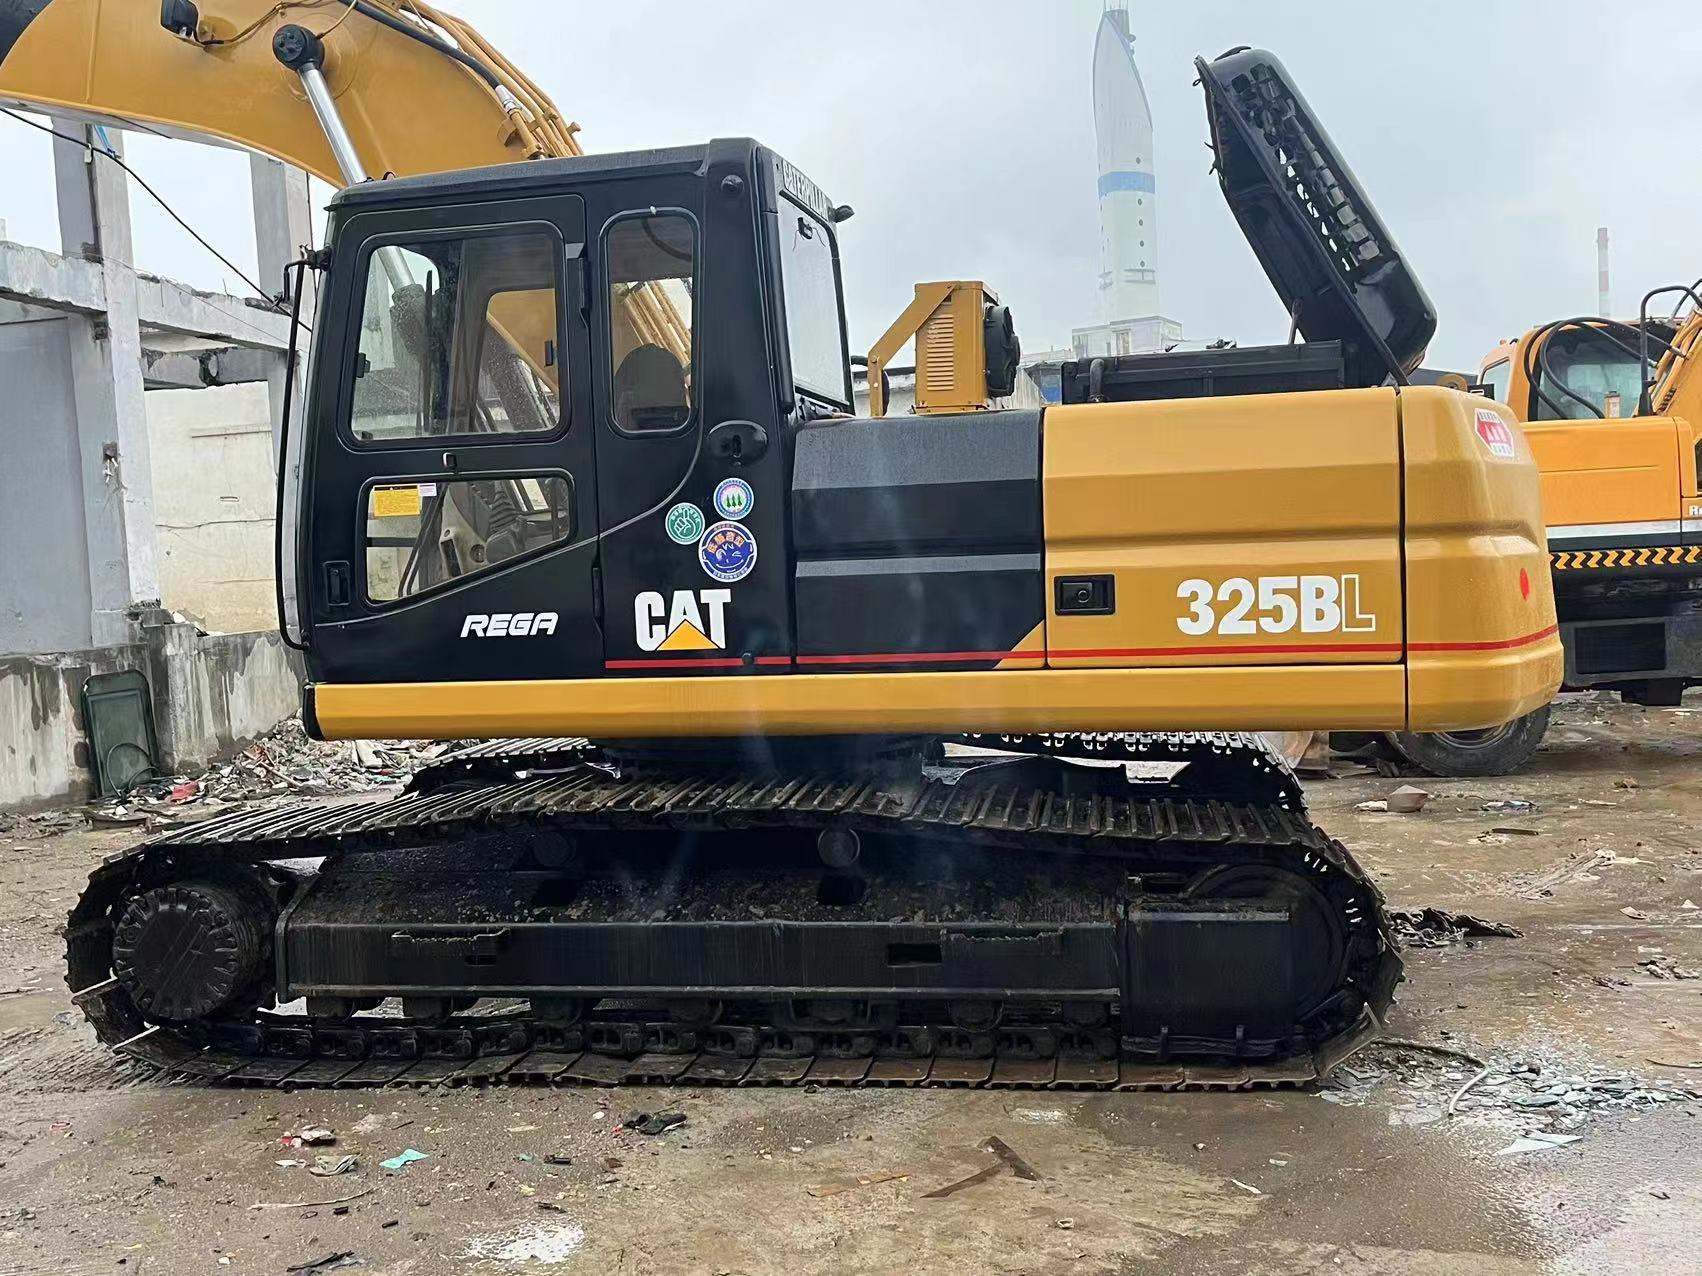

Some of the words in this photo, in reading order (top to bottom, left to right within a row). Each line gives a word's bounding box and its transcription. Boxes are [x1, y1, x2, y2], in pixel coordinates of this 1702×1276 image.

[460, 612, 559, 638] REGA
[634, 588, 732, 652] CAT
[1176, 573, 1376, 636] 325BL
